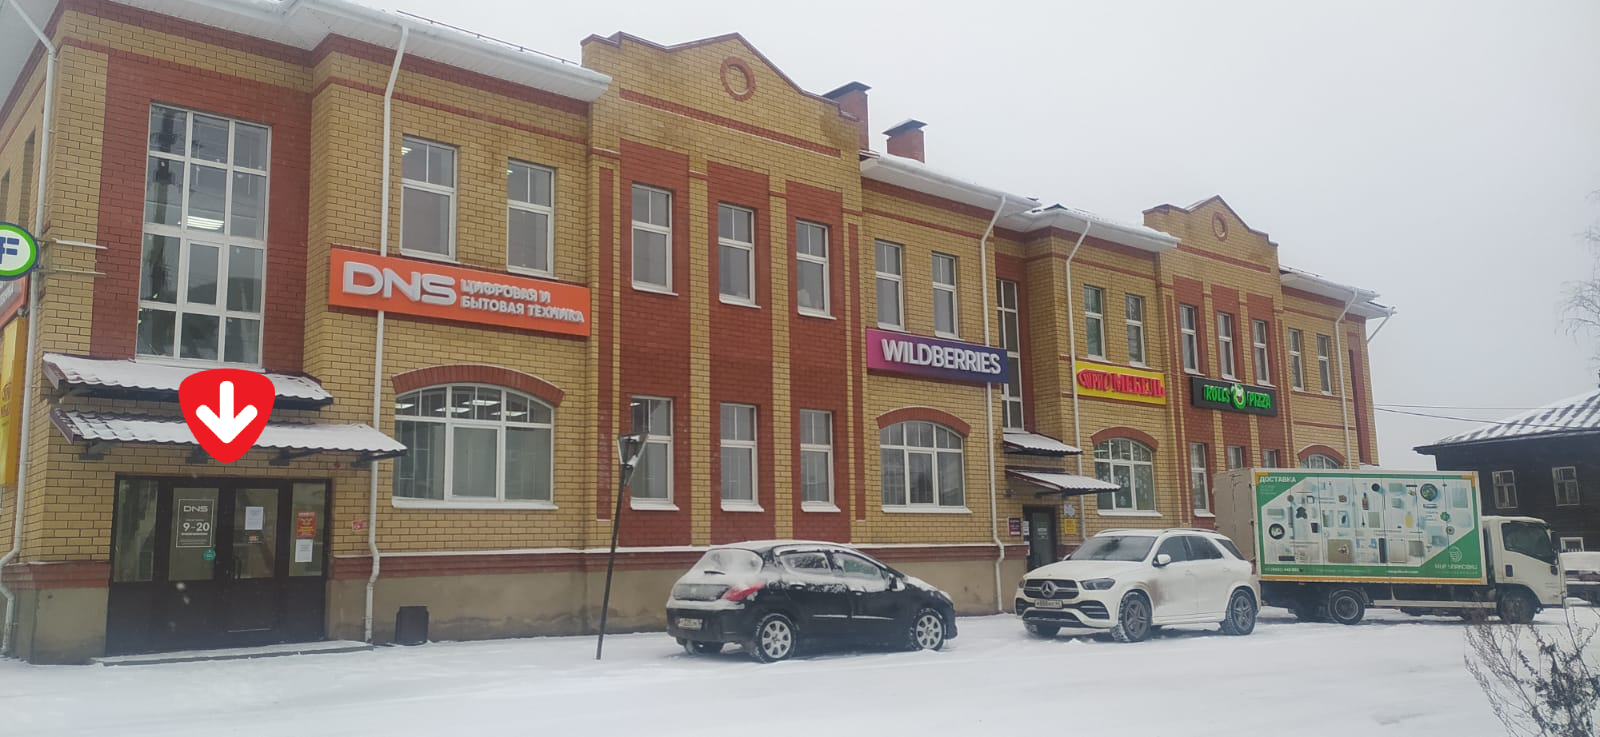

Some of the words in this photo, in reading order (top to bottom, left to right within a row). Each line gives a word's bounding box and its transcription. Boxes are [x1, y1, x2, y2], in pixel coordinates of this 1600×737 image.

[342, 261, 457, 306] DNS
[460, 279, 538, 302] ЦИФРОВАЯ
[539, 289, 551, 303] И
[460, 295, 525, 316] БЫТОВАЯ
[527, 304, 585, 323] ТЕХНИКА
[881, 338, 1002, 375] WILDBERRIES
[1111, 373, 1166, 398] МЕБЕЛЬ
[1203, 384, 1231, 403] ROLLS
[1247, 391, 1271, 409] PIZZA
[1259, 476, 1297, 484] ДОСТАВКА
[183, 505, 209, 513] DNS
